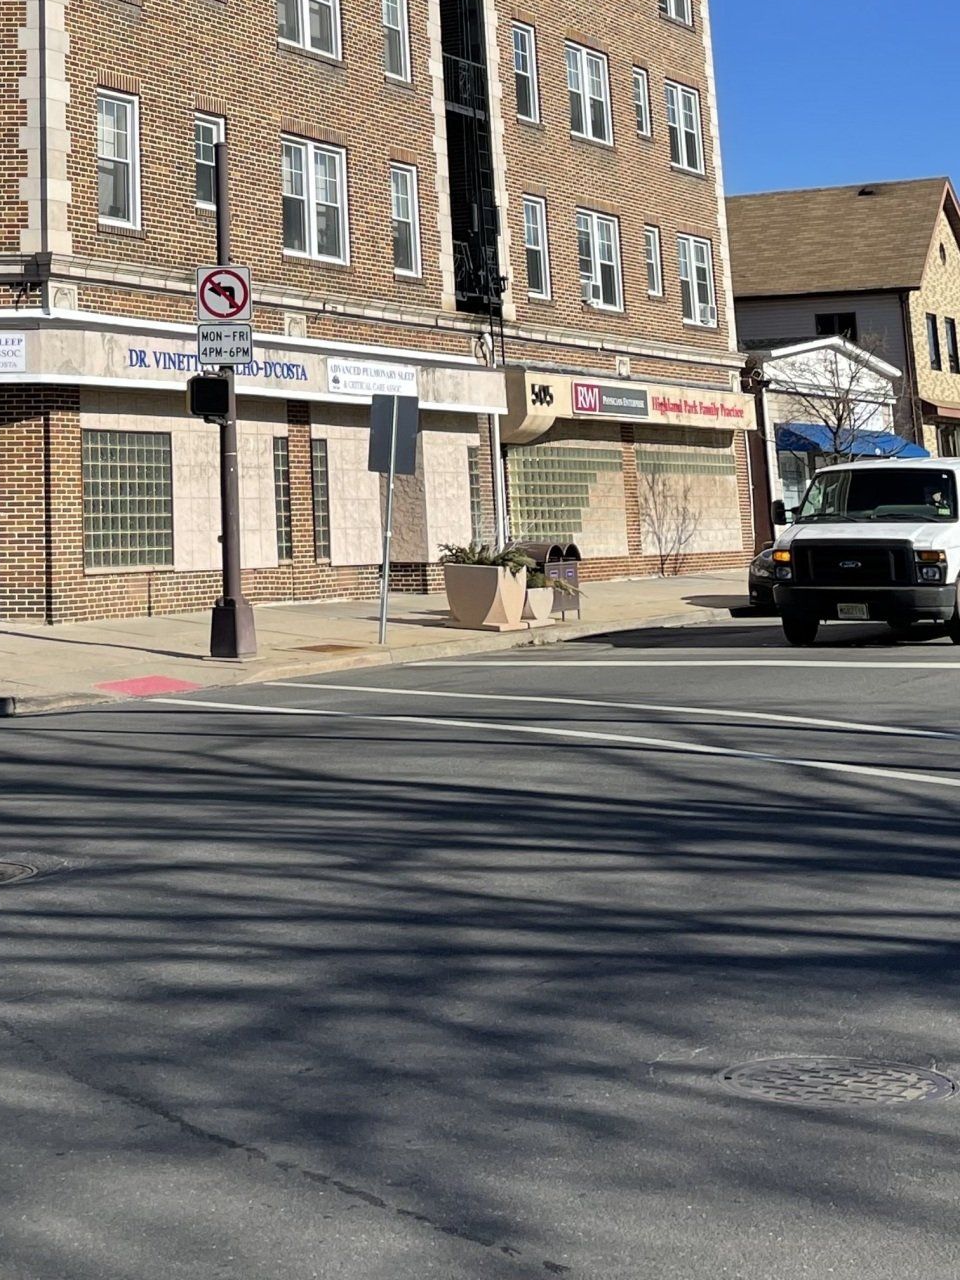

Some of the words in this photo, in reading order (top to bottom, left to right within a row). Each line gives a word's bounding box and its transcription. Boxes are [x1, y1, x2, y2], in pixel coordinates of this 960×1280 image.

[128, 348, 150, 368] DR.
[201, 347, 250, 358] 4PM-6PM
[330, 364, 361, 376] ADVANCED
[362, 367, 396, 380] PULMONARY
[397, 371, 415, 381] SLEEP
[531, 383, 554, 407] 505
[651, 396, 683, 416] Highland
[683, 400, 698, 414] Park
[698, 401, 719, 420] Family
[720, 403, 744, 418] Practice
